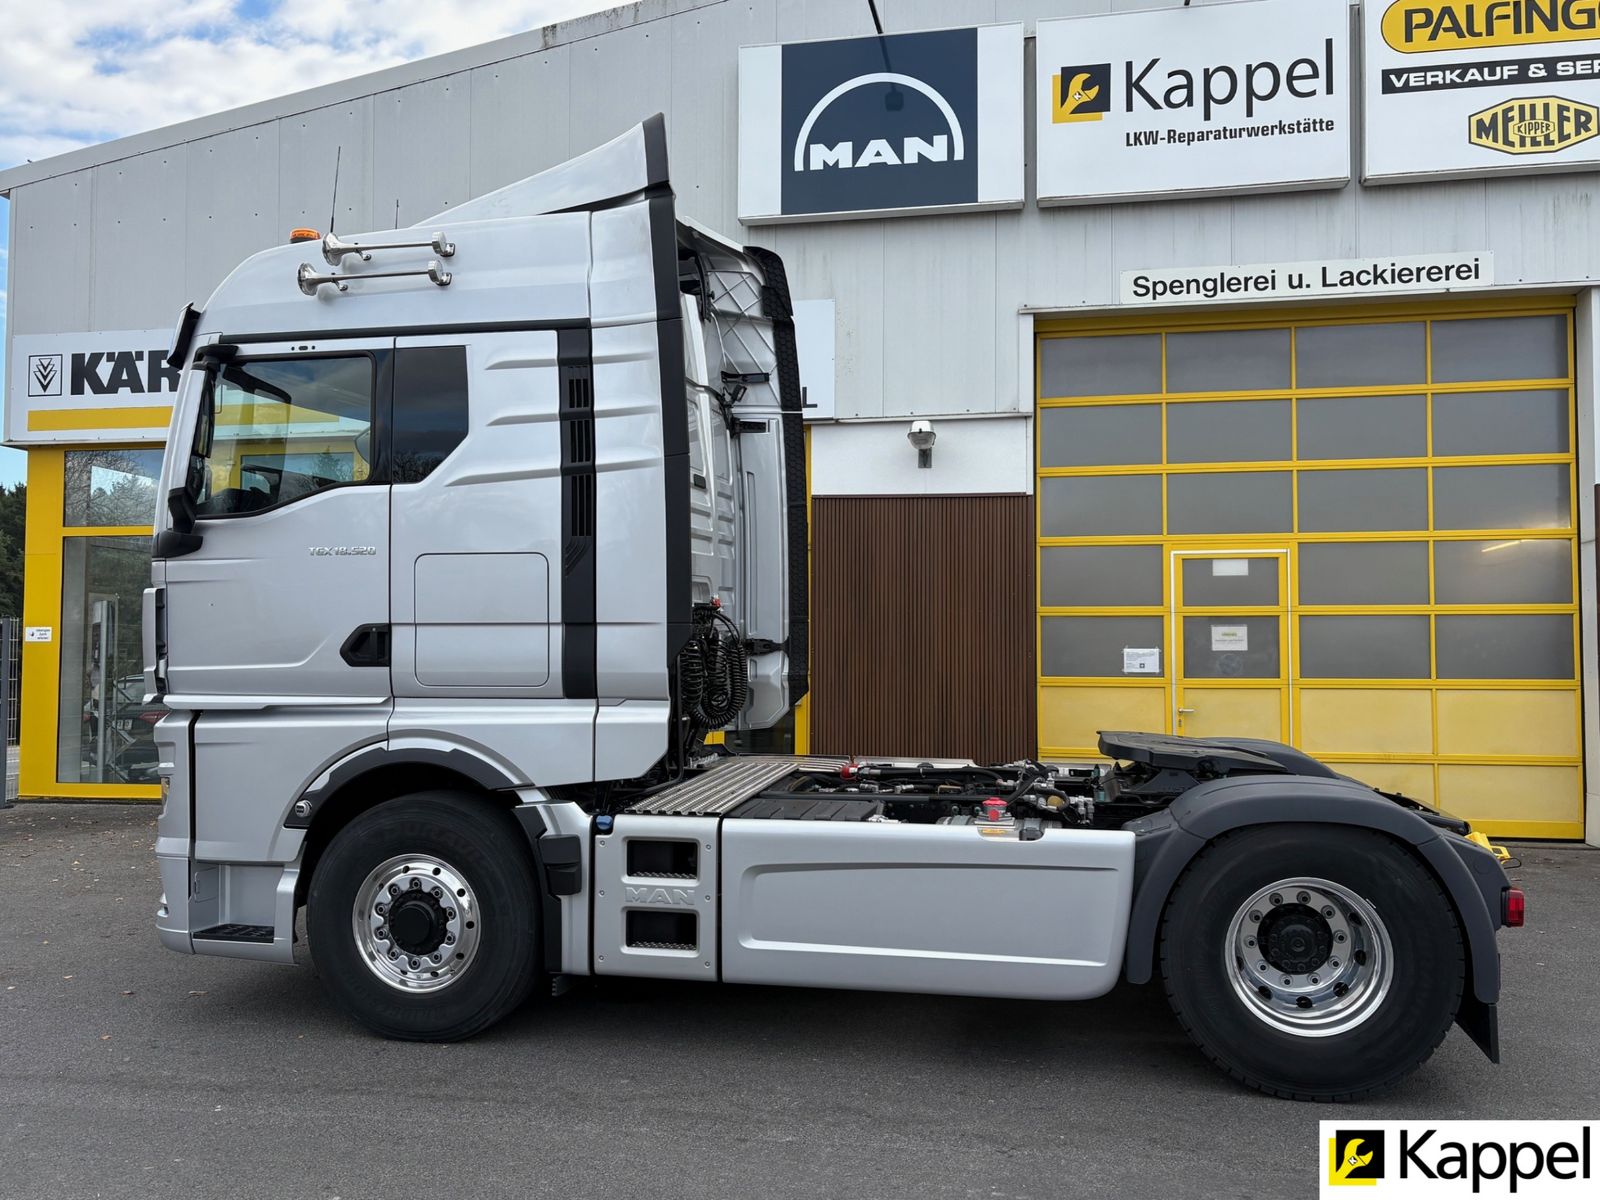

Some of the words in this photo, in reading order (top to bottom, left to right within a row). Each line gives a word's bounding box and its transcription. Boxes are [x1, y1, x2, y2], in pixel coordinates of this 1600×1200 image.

[1404, 0, 1600, 43] PALFING
[1125, 38, 1334, 121] Kappel
[1389, 64, 1519, 88] VERKAUF
[1528, 63, 1548, 78] &
[1125, 117, 1335, 147] LKW-Reparaturwerkstätte
[1476, 102, 1593, 148] MEILLER
[1517, 121, 1552, 136] KIPPER
[810, 134, 948, 171] MAN
[1132, 269, 1277, 300] Spenglerei
[1288, 273, 1311, 289] u.
[1321, 257, 1480, 288] Lackiererei
[624, 886, 696, 906] MAN
